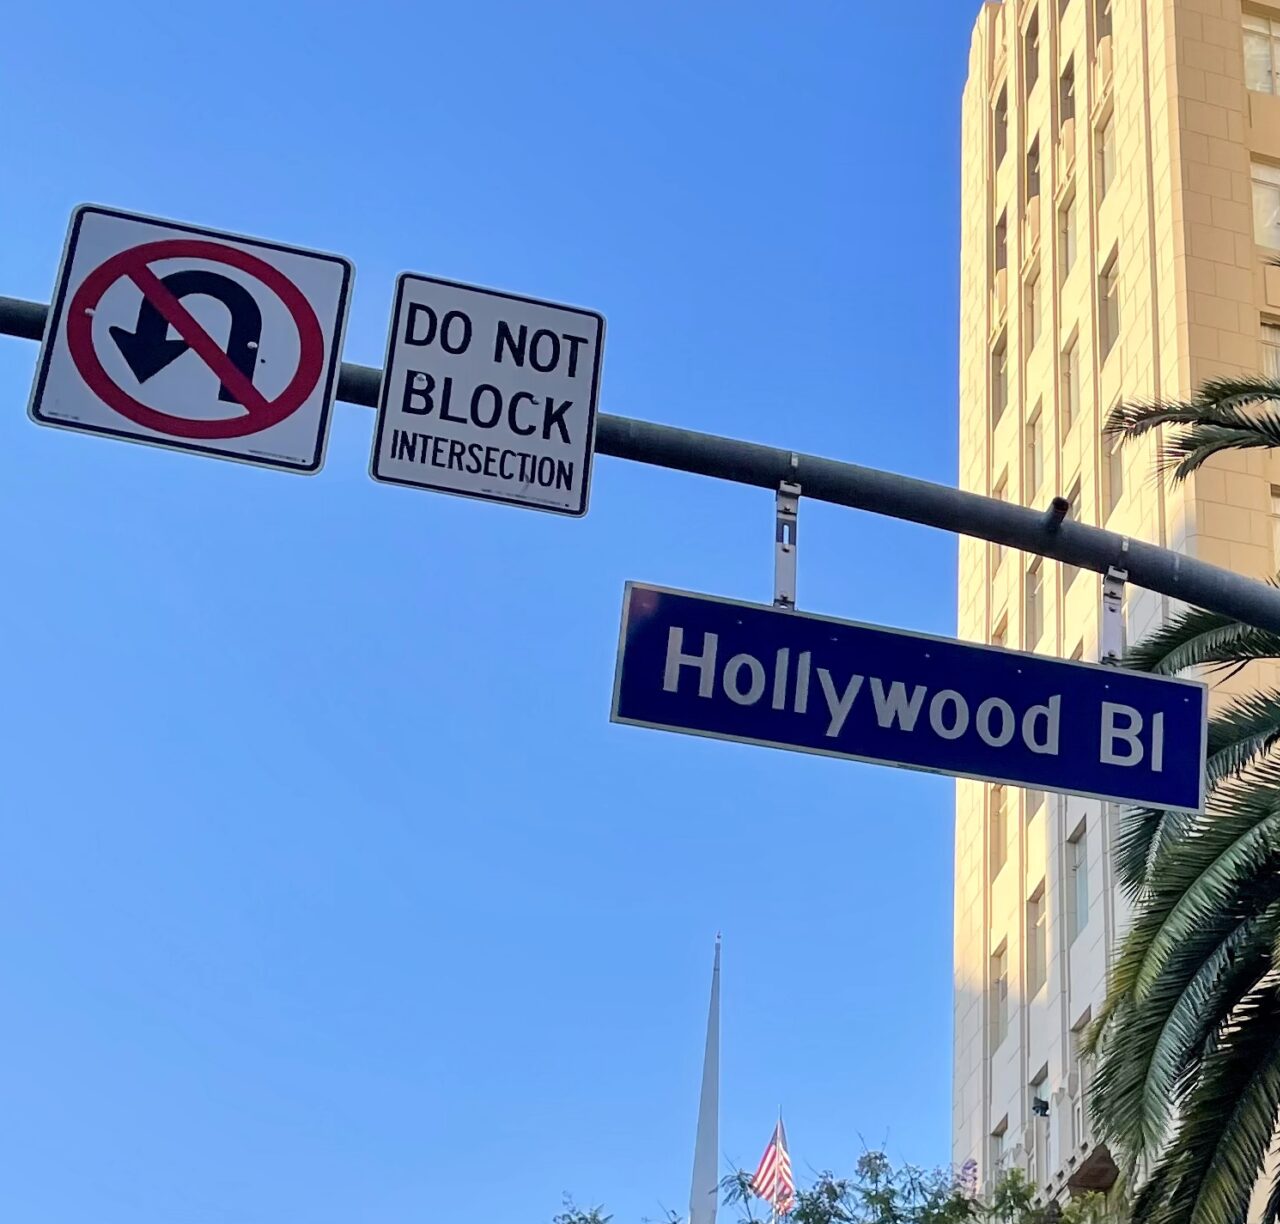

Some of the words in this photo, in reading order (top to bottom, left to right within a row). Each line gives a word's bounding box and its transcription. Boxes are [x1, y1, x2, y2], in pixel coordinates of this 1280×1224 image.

[404, 303, 472, 355] DO
[493, 320, 589, 379] NOT
[401, 369, 574, 444] BLOCK
[389, 429, 574, 491] INTERSECTION
[663, 626, 1062, 757] Hollywood
[1099, 701, 1164, 773] Bl
